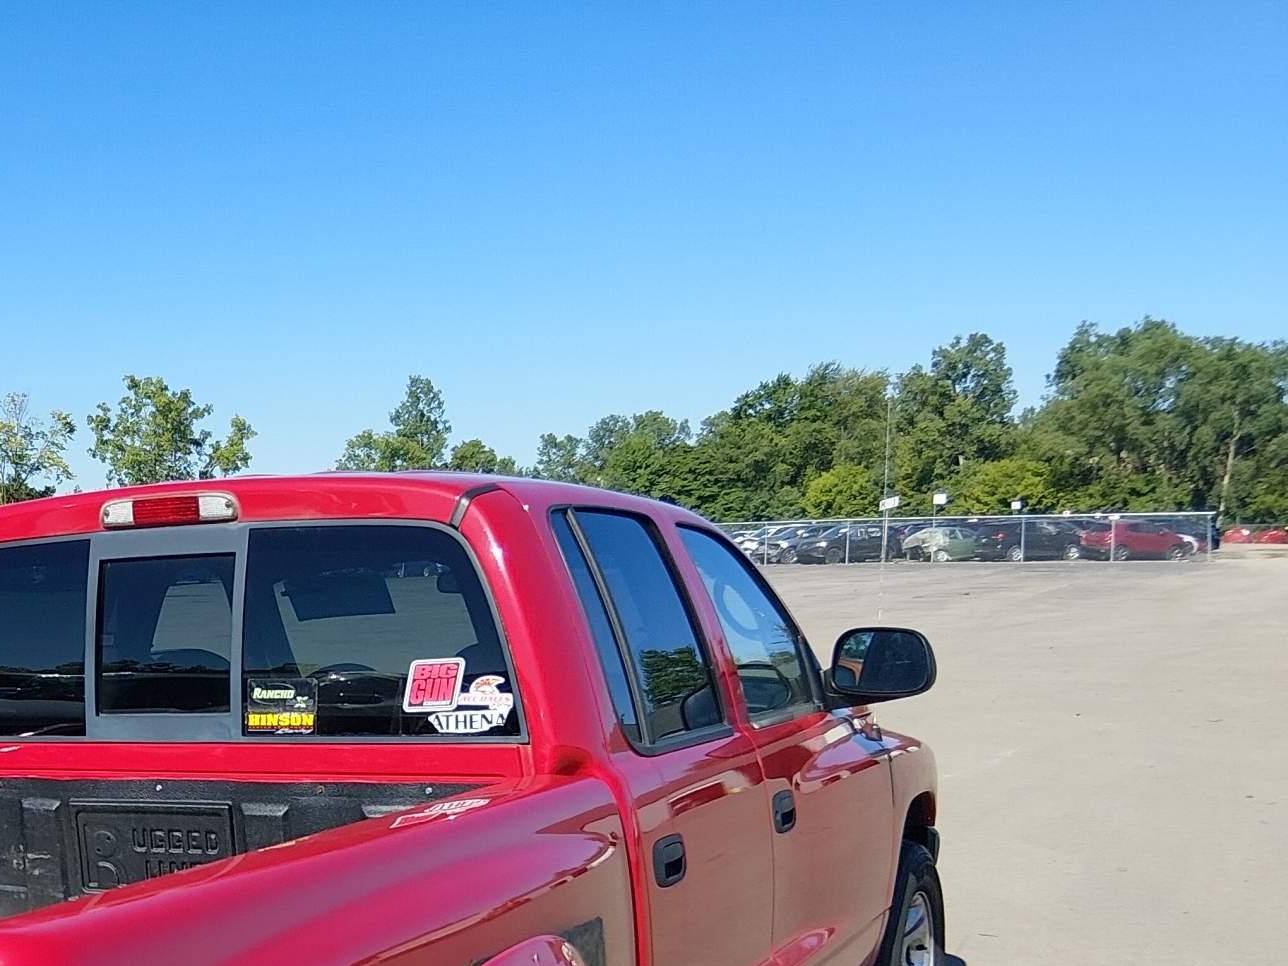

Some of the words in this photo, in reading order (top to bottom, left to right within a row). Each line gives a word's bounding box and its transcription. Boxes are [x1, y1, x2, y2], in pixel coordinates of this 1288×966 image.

[414, 664, 458, 680] BIG
[253, 688, 295, 699] RANCHO
[410, 679, 455, 704] GUN
[248, 712, 314, 726] HINSON
[433, 713, 505, 731] ATHENA
